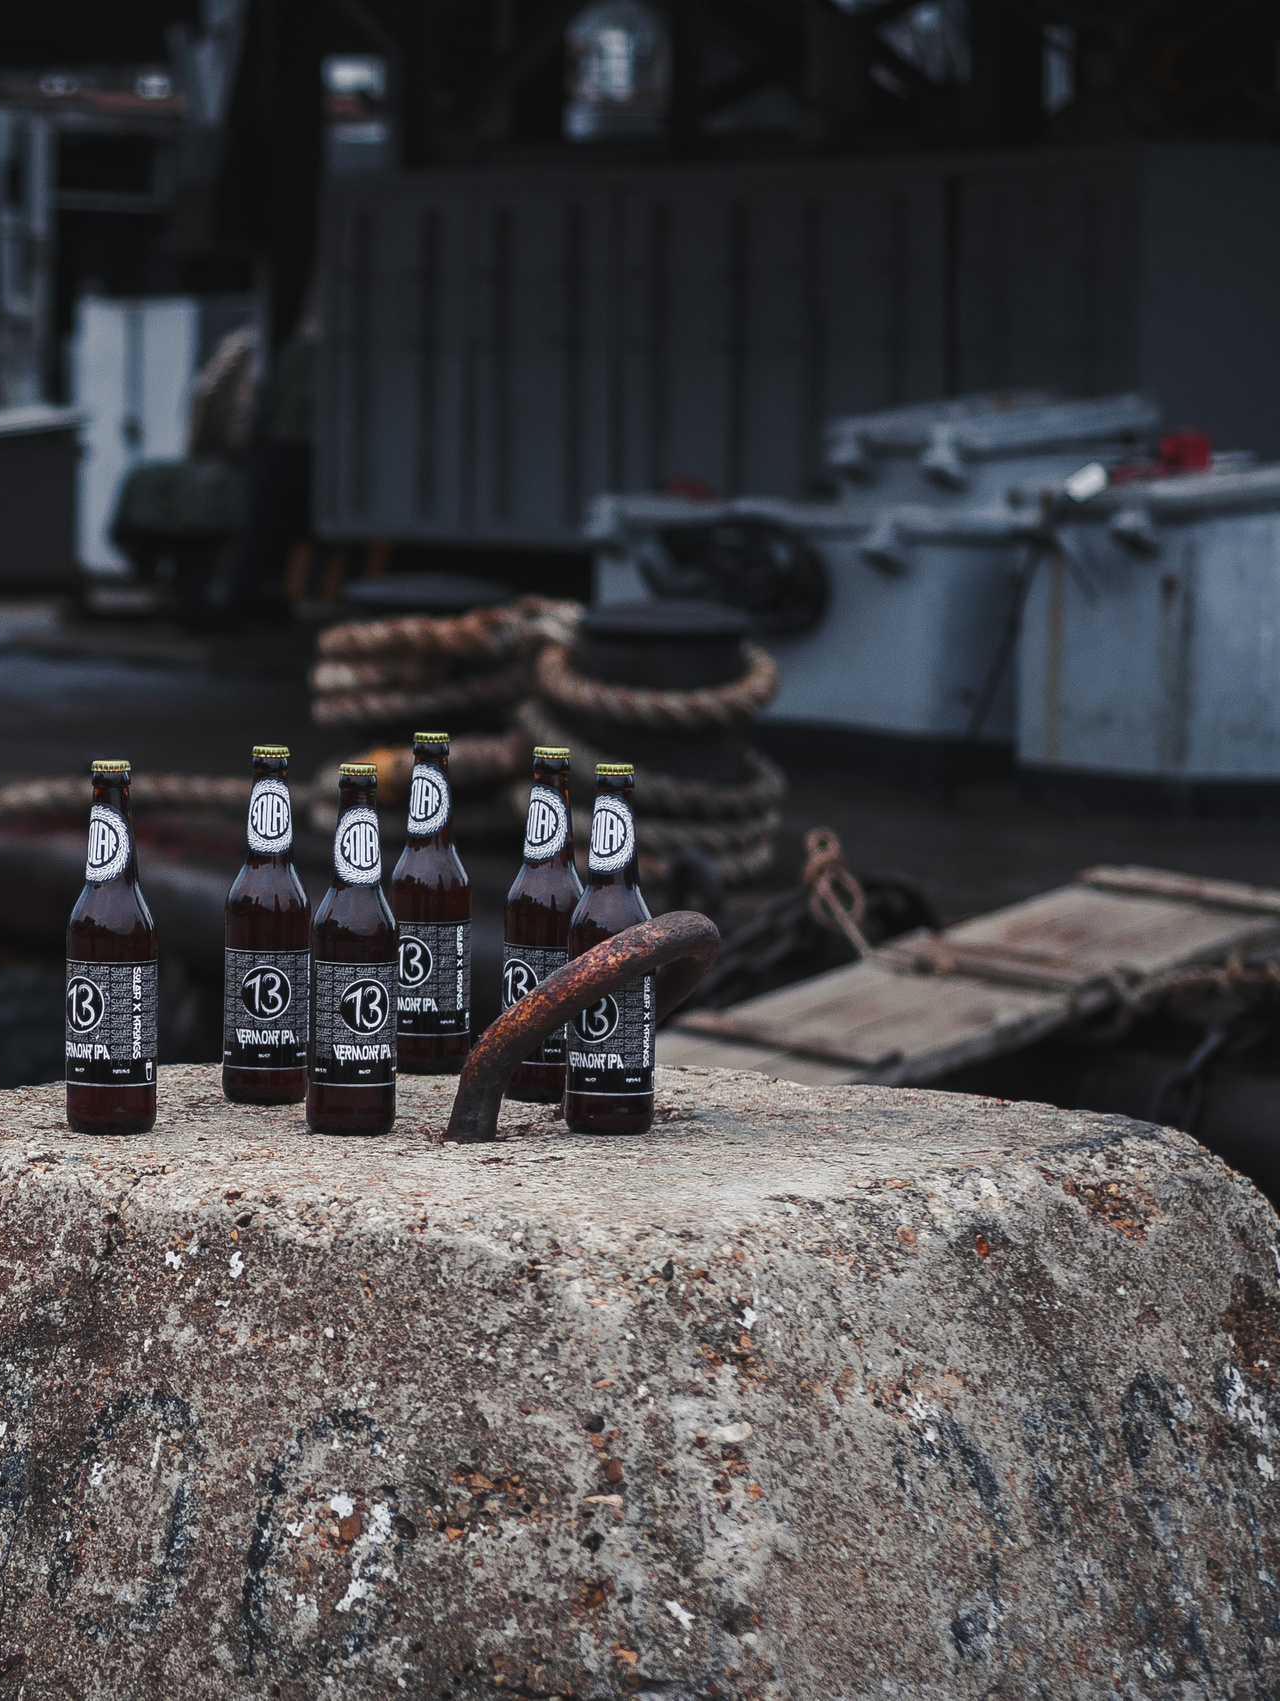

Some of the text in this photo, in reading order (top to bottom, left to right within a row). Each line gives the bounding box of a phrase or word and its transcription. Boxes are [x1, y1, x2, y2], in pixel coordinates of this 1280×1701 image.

[252, 793, 289, 838] SOLAR
[410, 778, 440, 820] OLAR
[526, 800, 557, 844] OLAR
[87, 820, 118, 866] OLAR
[398, 942, 424, 983] 13
[456, 958, 463, 967] X
[132, 966, 142, 1001] SOLAR
[244, 972, 283, 1016] 13
[643, 975, 651, 1010] SOLAR
[67, 983, 96, 1028] 13
[132, 1002, 142, 1012] X
[343, 985, 383, 1031] 13
[422, 997, 439, 1013] IPA
[643, 1011, 650, 1021] X
[94, 1043, 111, 1060] IPA
[235, 1028, 296, 1047] VERMONT IPA
[332, 1043, 392, 1063] VERMONT IPA
[607, 1053, 625, 1069] IPA
